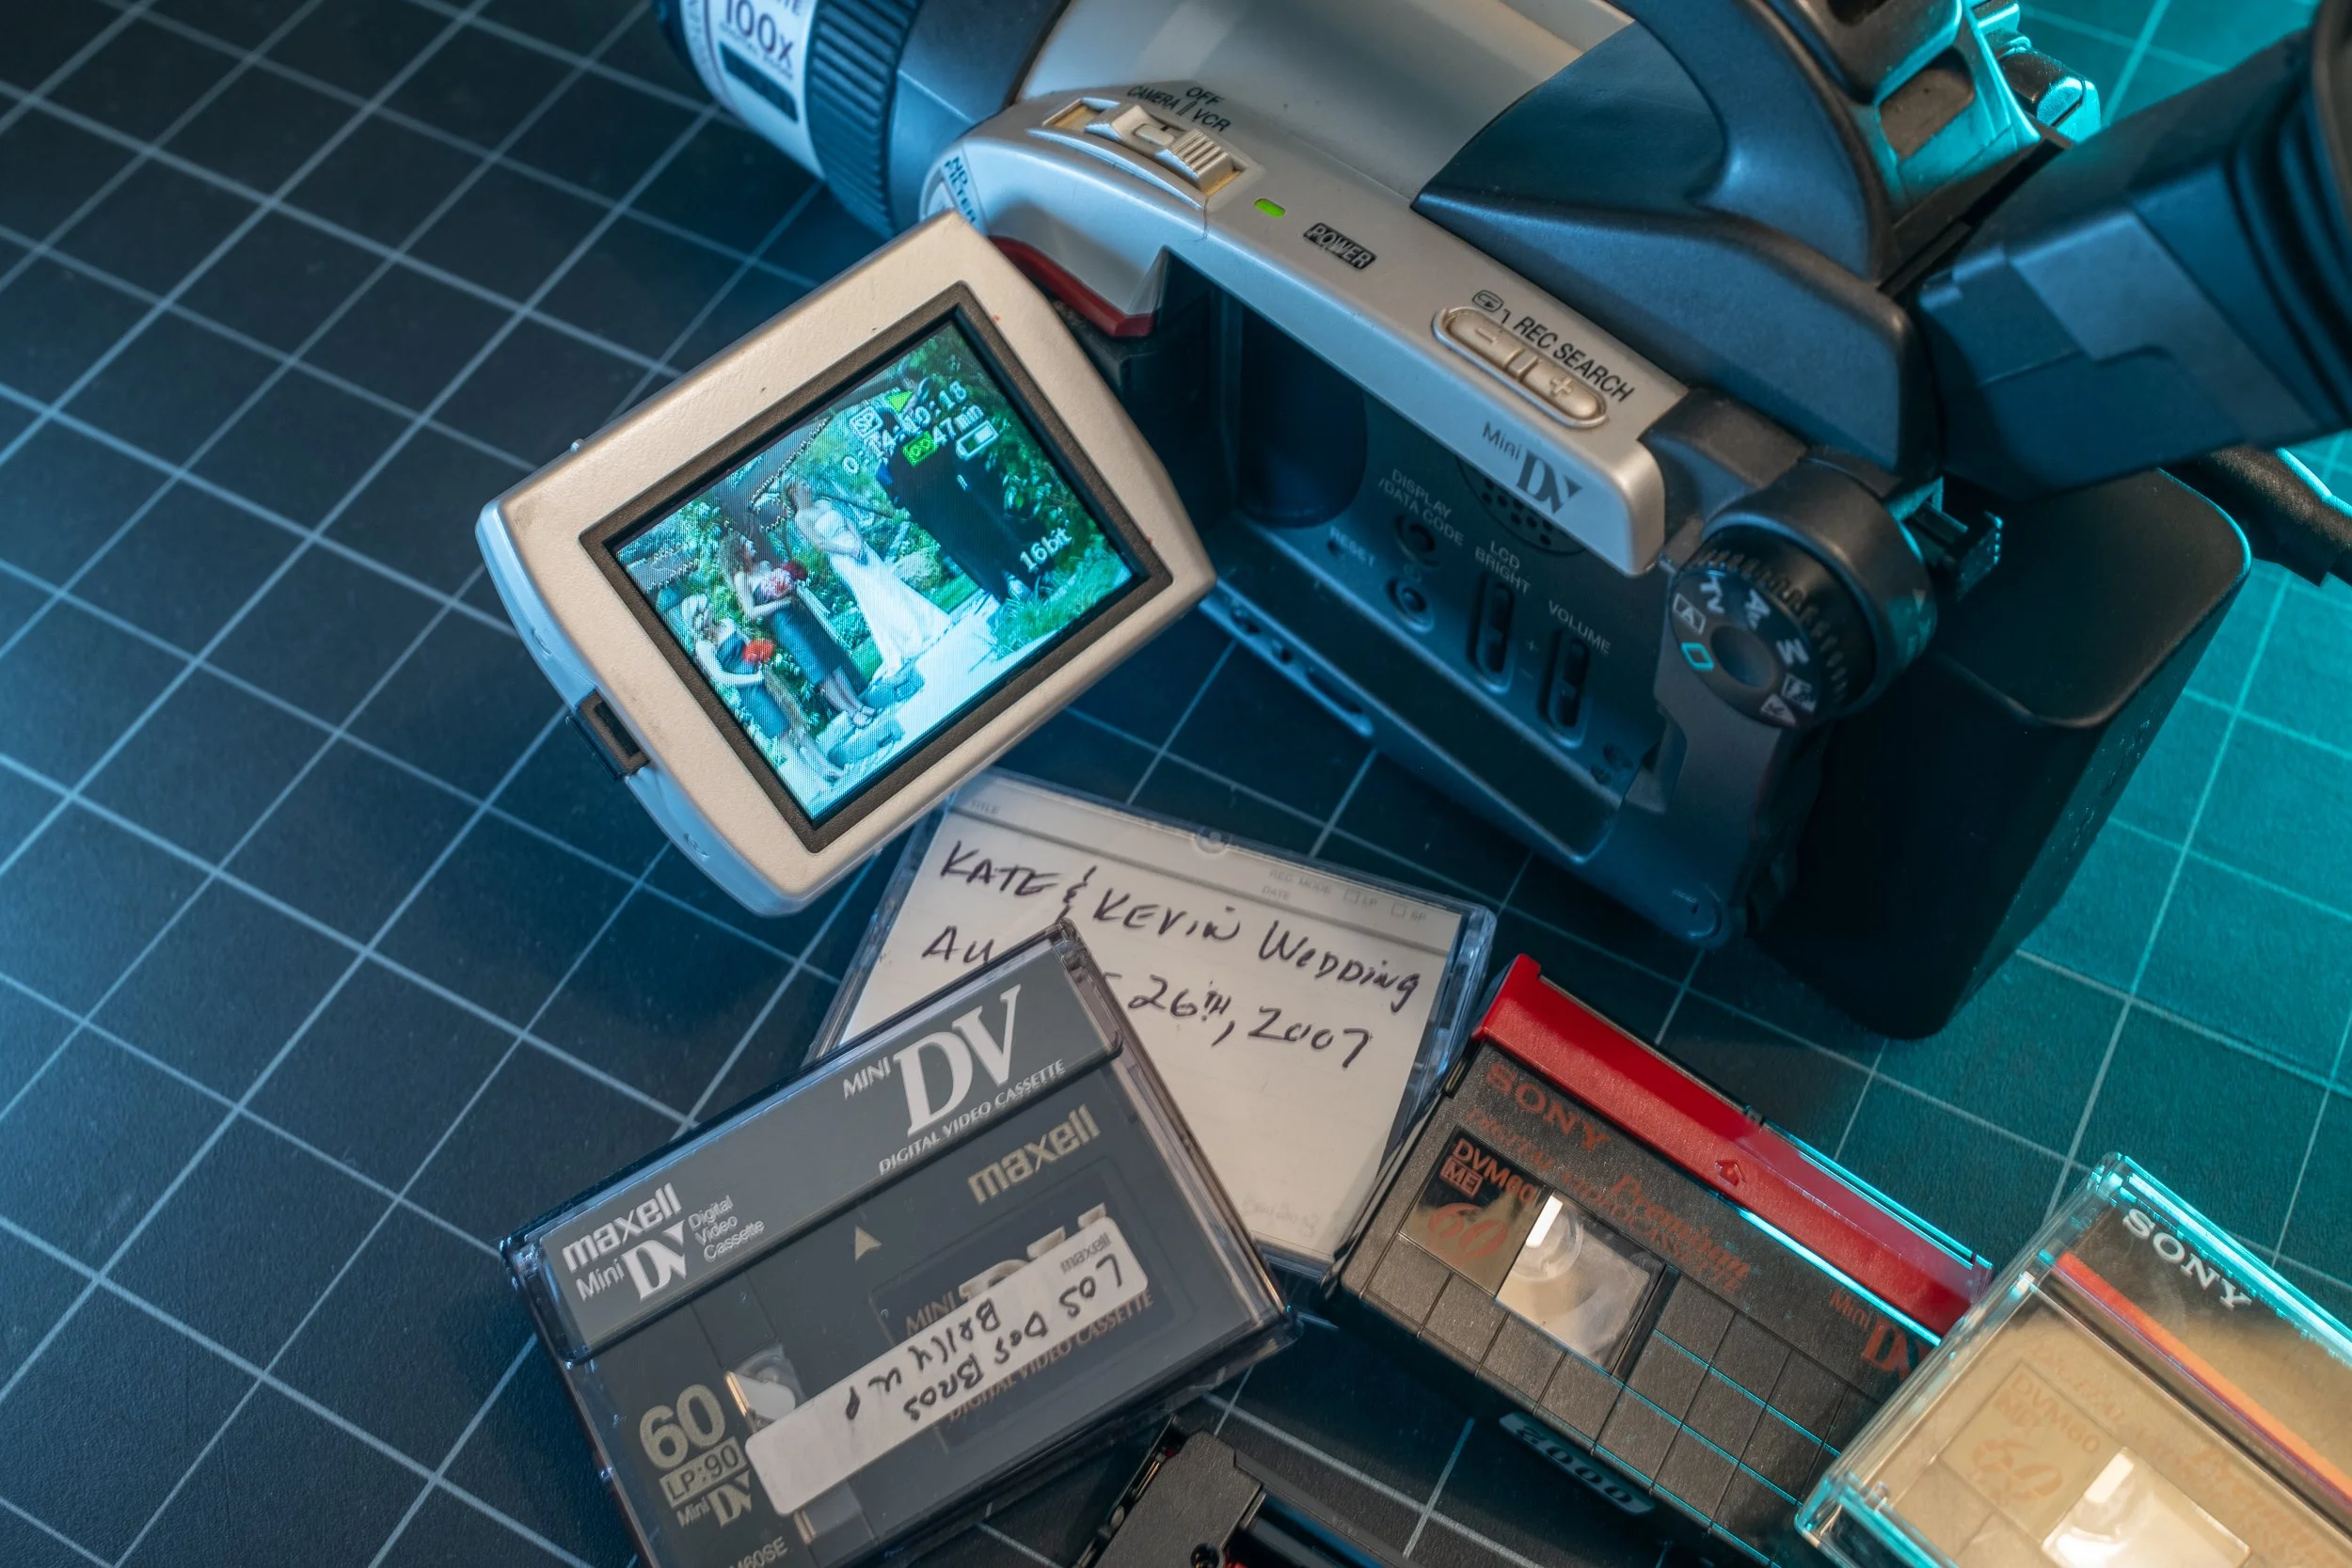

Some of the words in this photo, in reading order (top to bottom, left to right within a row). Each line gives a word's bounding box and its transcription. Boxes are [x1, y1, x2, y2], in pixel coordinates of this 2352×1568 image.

[1126, 85, 1182, 111] CAMERA
[1184, 86, 1224, 105] OFF
[1192, 107, 1232, 133] VCR
[1306, 225, 1375, 269] POWER
[1513, 315, 1559, 351] REC
[1552, 341, 1636, 404] SEARCH
[932, 404, 985, 448] 47min
[1482, 420, 1522, 461] Mini
[1516, 449, 1584, 515] DV
[1391, 468, 1453, 518] DISPLAY
[1329, 525, 1377, 566] RESET
[1422, 504, 1466, 546] CODE
[1019, 527, 1073, 574] 16bit
[1474, 546, 1532, 594] BRIGHT
[1489, 539, 1521, 570] LCD
[1548, 599, 1612, 655] VOLUME
[940, 840, 1062, 895] KATE
[842, 1055, 892, 1101] MINI
[892, 983, 1022, 1138] DV
[1247, 1005, 1375, 1069] 2007
[878, 1129, 941, 1177] DIGITAL
[943, 1101, 992, 1140] VIDEO
[993, 1058, 1068, 1110] CASSETTE
[1485, 1061, 1611, 1152] SONY
[966, 1103, 1102, 1205] maxell
[1441, 1156, 1483, 1197] ME
[562, 1181, 682, 1272] maxell
[688, 1195, 734, 1232] Digital
[694, 1214, 739, 1246] Video
[575, 1259, 625, 1303] Mini
[621, 1219, 687, 1303] DV
[703, 1218, 765, 1263] Cassette
[1059, 1231, 1112, 1275] maxell
[2122, 1207, 2252, 1311] SONY
[905, 1290, 958, 1337] MINI
[639, 1384, 726, 1470] 60
[2011, 1370, 2102, 1454] DVM60
[675, 1495, 711, 1529] Mini
[707, 1469, 753, 1528] DV
